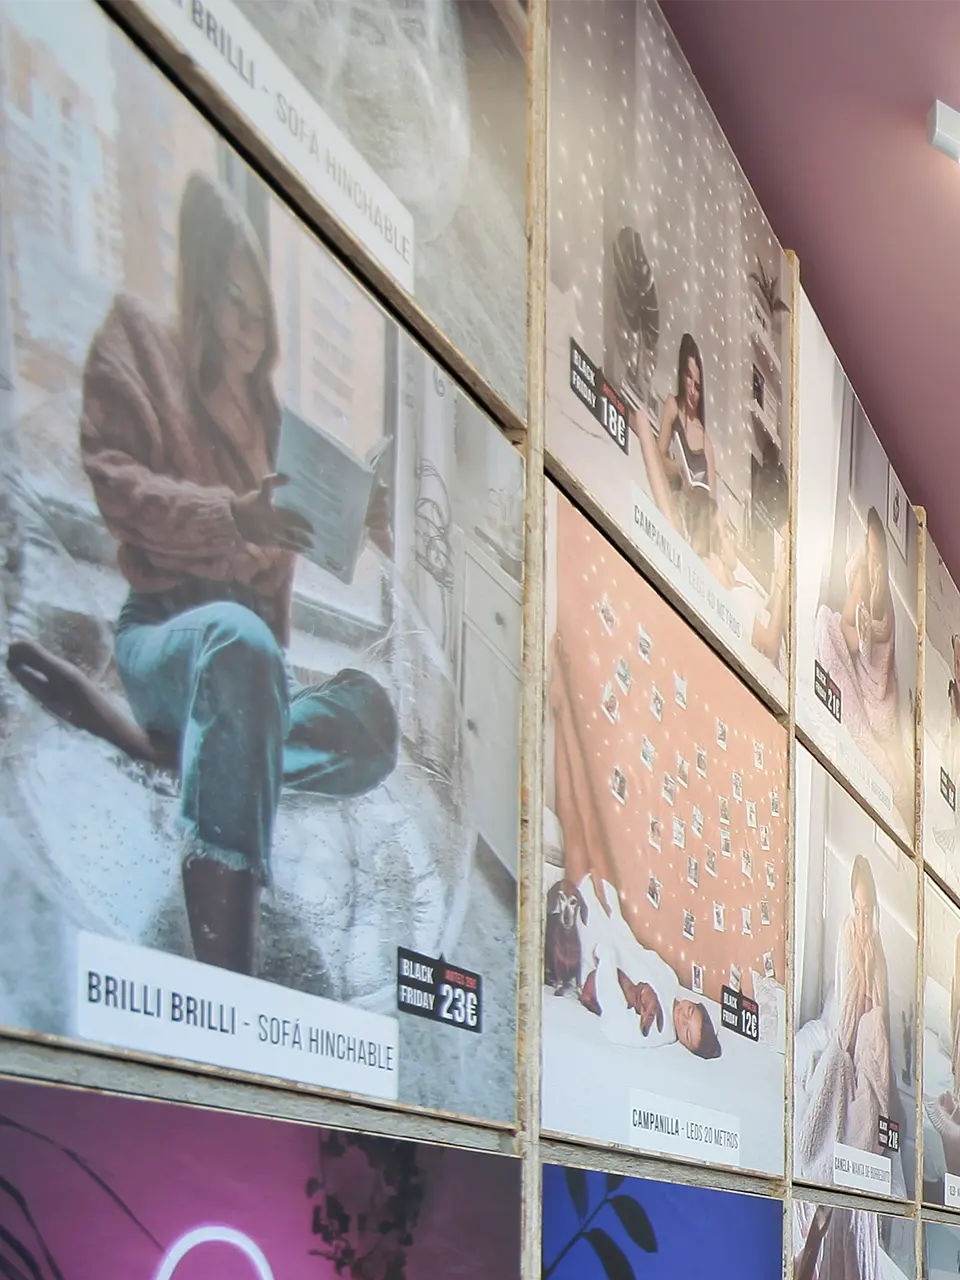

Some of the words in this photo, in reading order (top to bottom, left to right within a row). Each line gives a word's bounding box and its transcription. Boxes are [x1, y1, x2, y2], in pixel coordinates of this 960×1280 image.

[191, 0, 255, 89] BRILLI
[325, 147, 411, 264] HINCHABLE
[574, 349, 596, 386] BLACK
[573, 370, 597, 408] FRIDAY
[600, 396, 626, 446] 18€
[634, 504, 682, 573] CAMPANILLA
[402, 958, 434, 984] BLACK
[400, 985, 435, 1011] FRIDAY
[441, 984, 477, 1027] 23€
[723, 992, 738, 1009] BLACK
[88, 970, 162, 1018] BRILLI
[171, 992, 236, 1035] BRILLI
[258, 1014, 303, 1050] SOFÁ
[309, 1027, 394, 1071] HINCHABLE
[741, 1009, 757, 1038] 12€
[632, 1109, 680, 1137] CAMPANILLA
[686, 1121, 703, 1142] LEDS
[704, 1126, 713, 1144] 20
[714, 1130, 739, 1149] METROS
